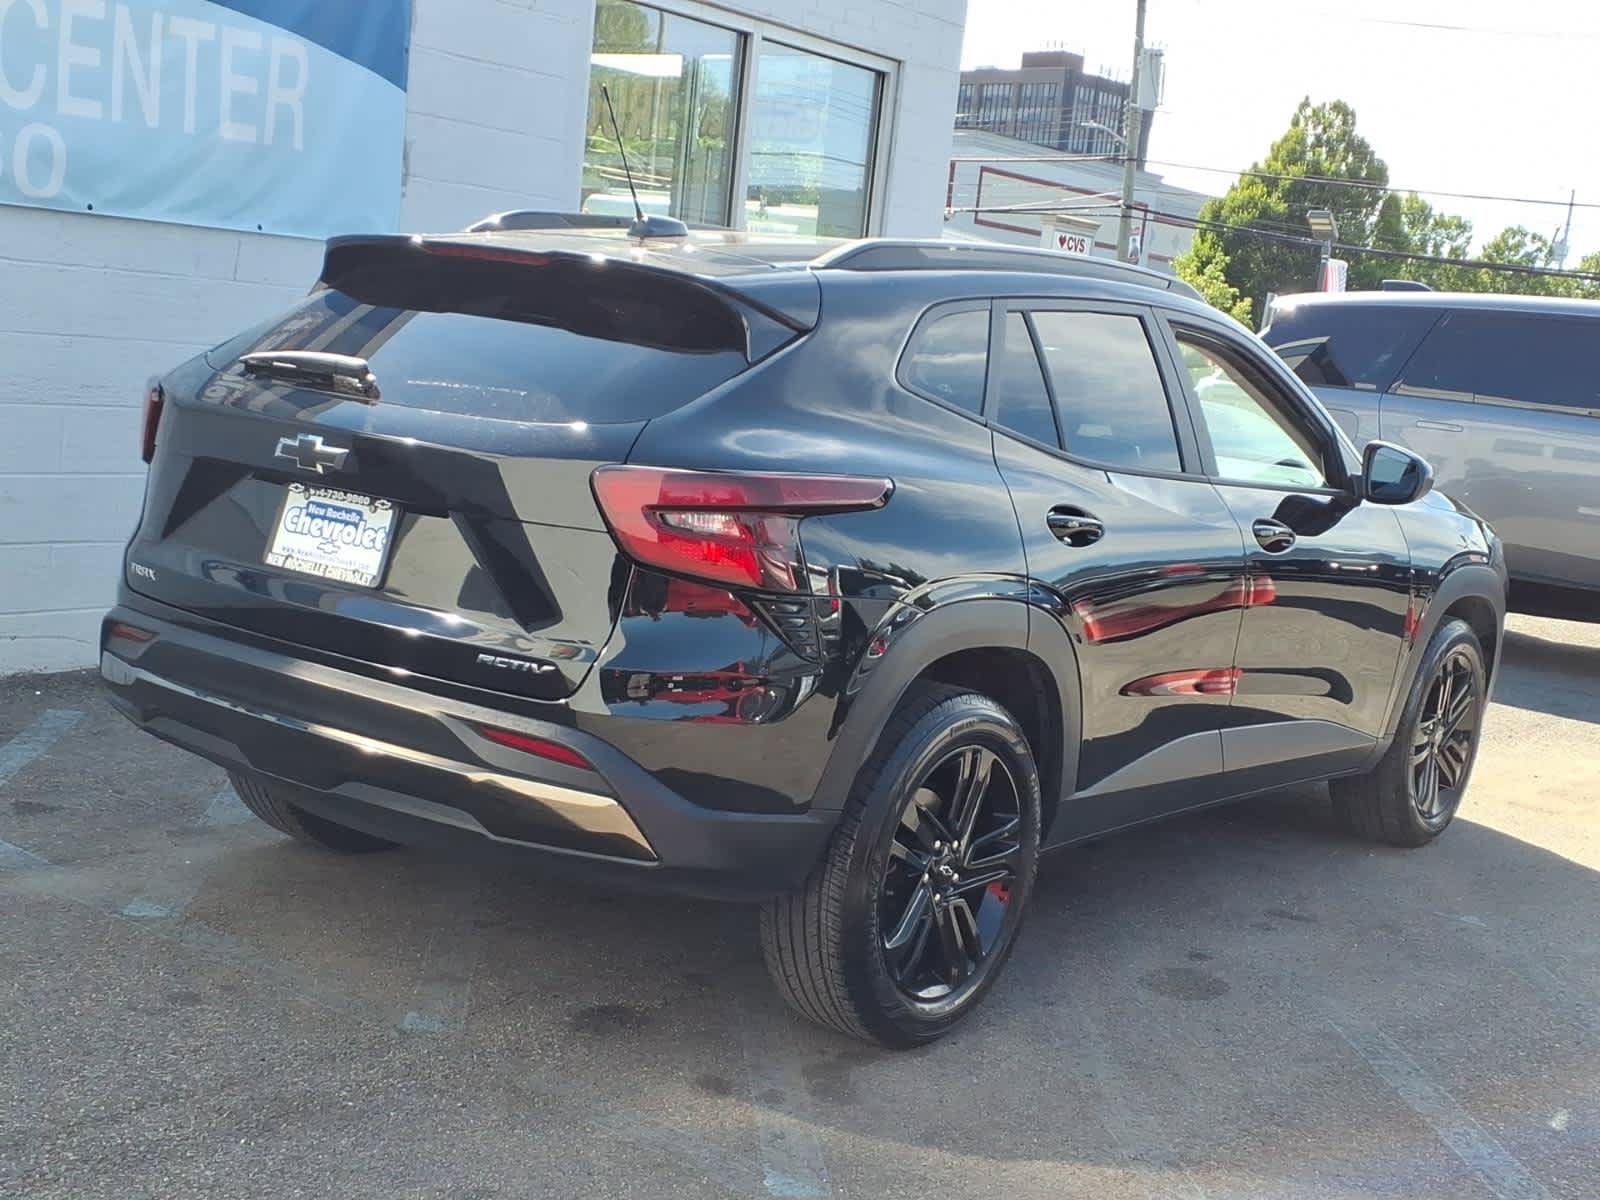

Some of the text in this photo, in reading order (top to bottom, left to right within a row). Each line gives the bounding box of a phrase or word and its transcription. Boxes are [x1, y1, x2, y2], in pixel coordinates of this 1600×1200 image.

[0, 0, 309, 151] CENTER
[1066, 236, 1086, 253] CVS
[308, 503, 361, 523] New Rochelle
[284, 506, 388, 552] Chevrolet
[131, 562, 156, 581] TRAX
[476, 653, 556, 674] ACTIV
